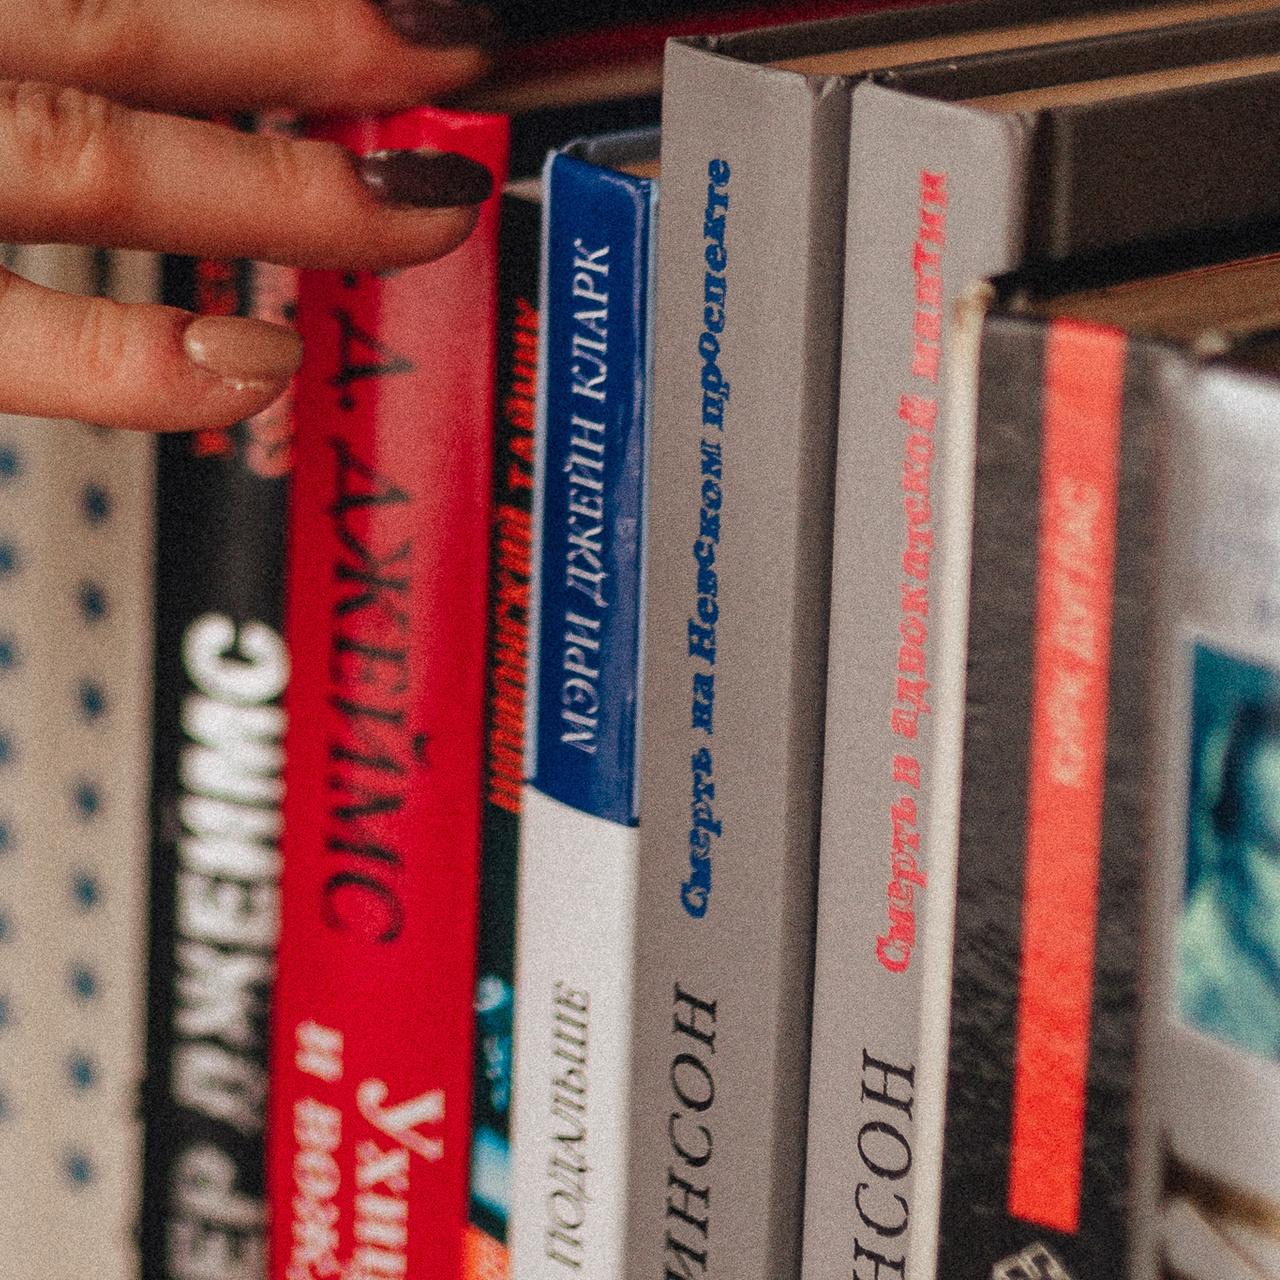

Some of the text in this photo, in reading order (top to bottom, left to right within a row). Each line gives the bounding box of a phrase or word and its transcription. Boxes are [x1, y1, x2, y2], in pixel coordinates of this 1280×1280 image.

[322, 438, 434, 943] ДЖЕЙМС
[559, 237, 613, 756] МЭРИ ДЖЕЙН КЛАРК
[680, 157, 732, 920] Смерть на Невском проспекте
[875, 170, 952, 975] Смерть в адвокатской мантии
[544, 979, 594, 1271] ПОДАЛЬШЕ
